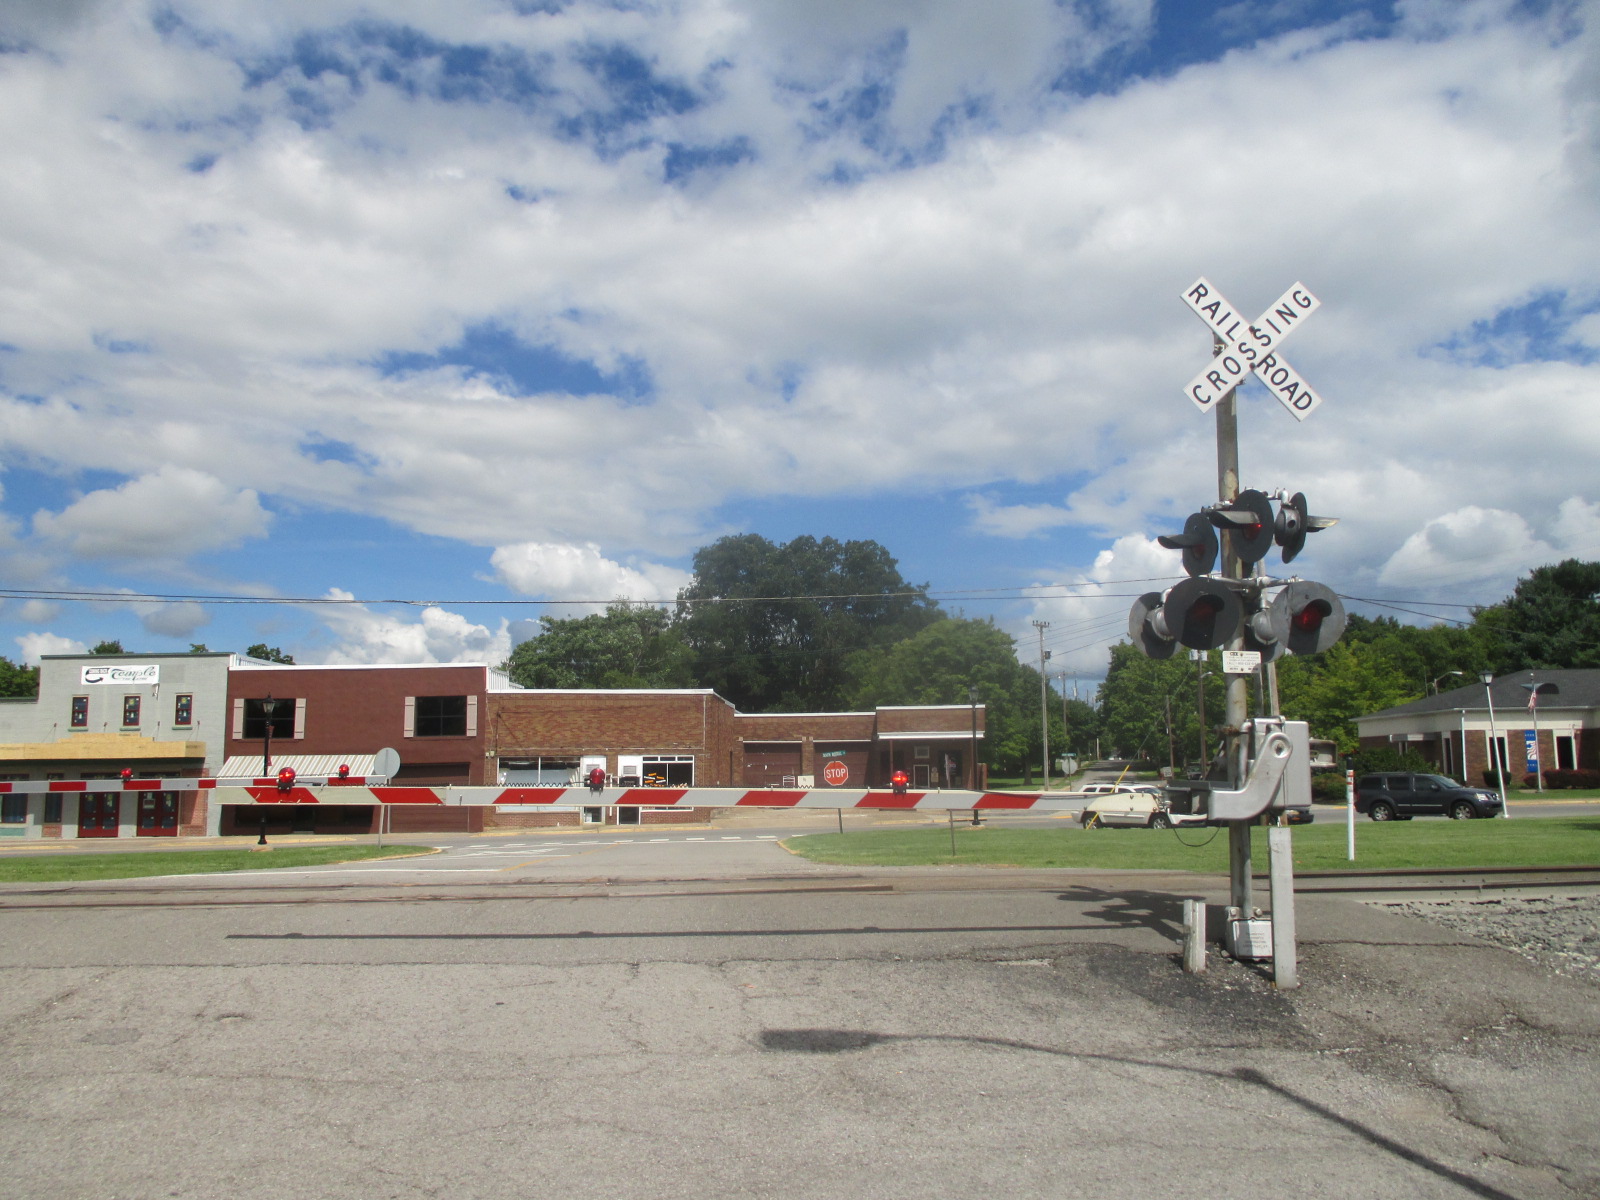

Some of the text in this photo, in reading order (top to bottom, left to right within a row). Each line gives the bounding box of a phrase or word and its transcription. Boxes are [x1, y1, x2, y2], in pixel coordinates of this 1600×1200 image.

[1188, 283, 1241, 342] RAIL
[1192, 290, 1312, 405] CROSSING
[1256, 353, 1313, 411] ROAD
[111, 666, 156, 681] Temple
[826, 768, 846, 778] STOP
